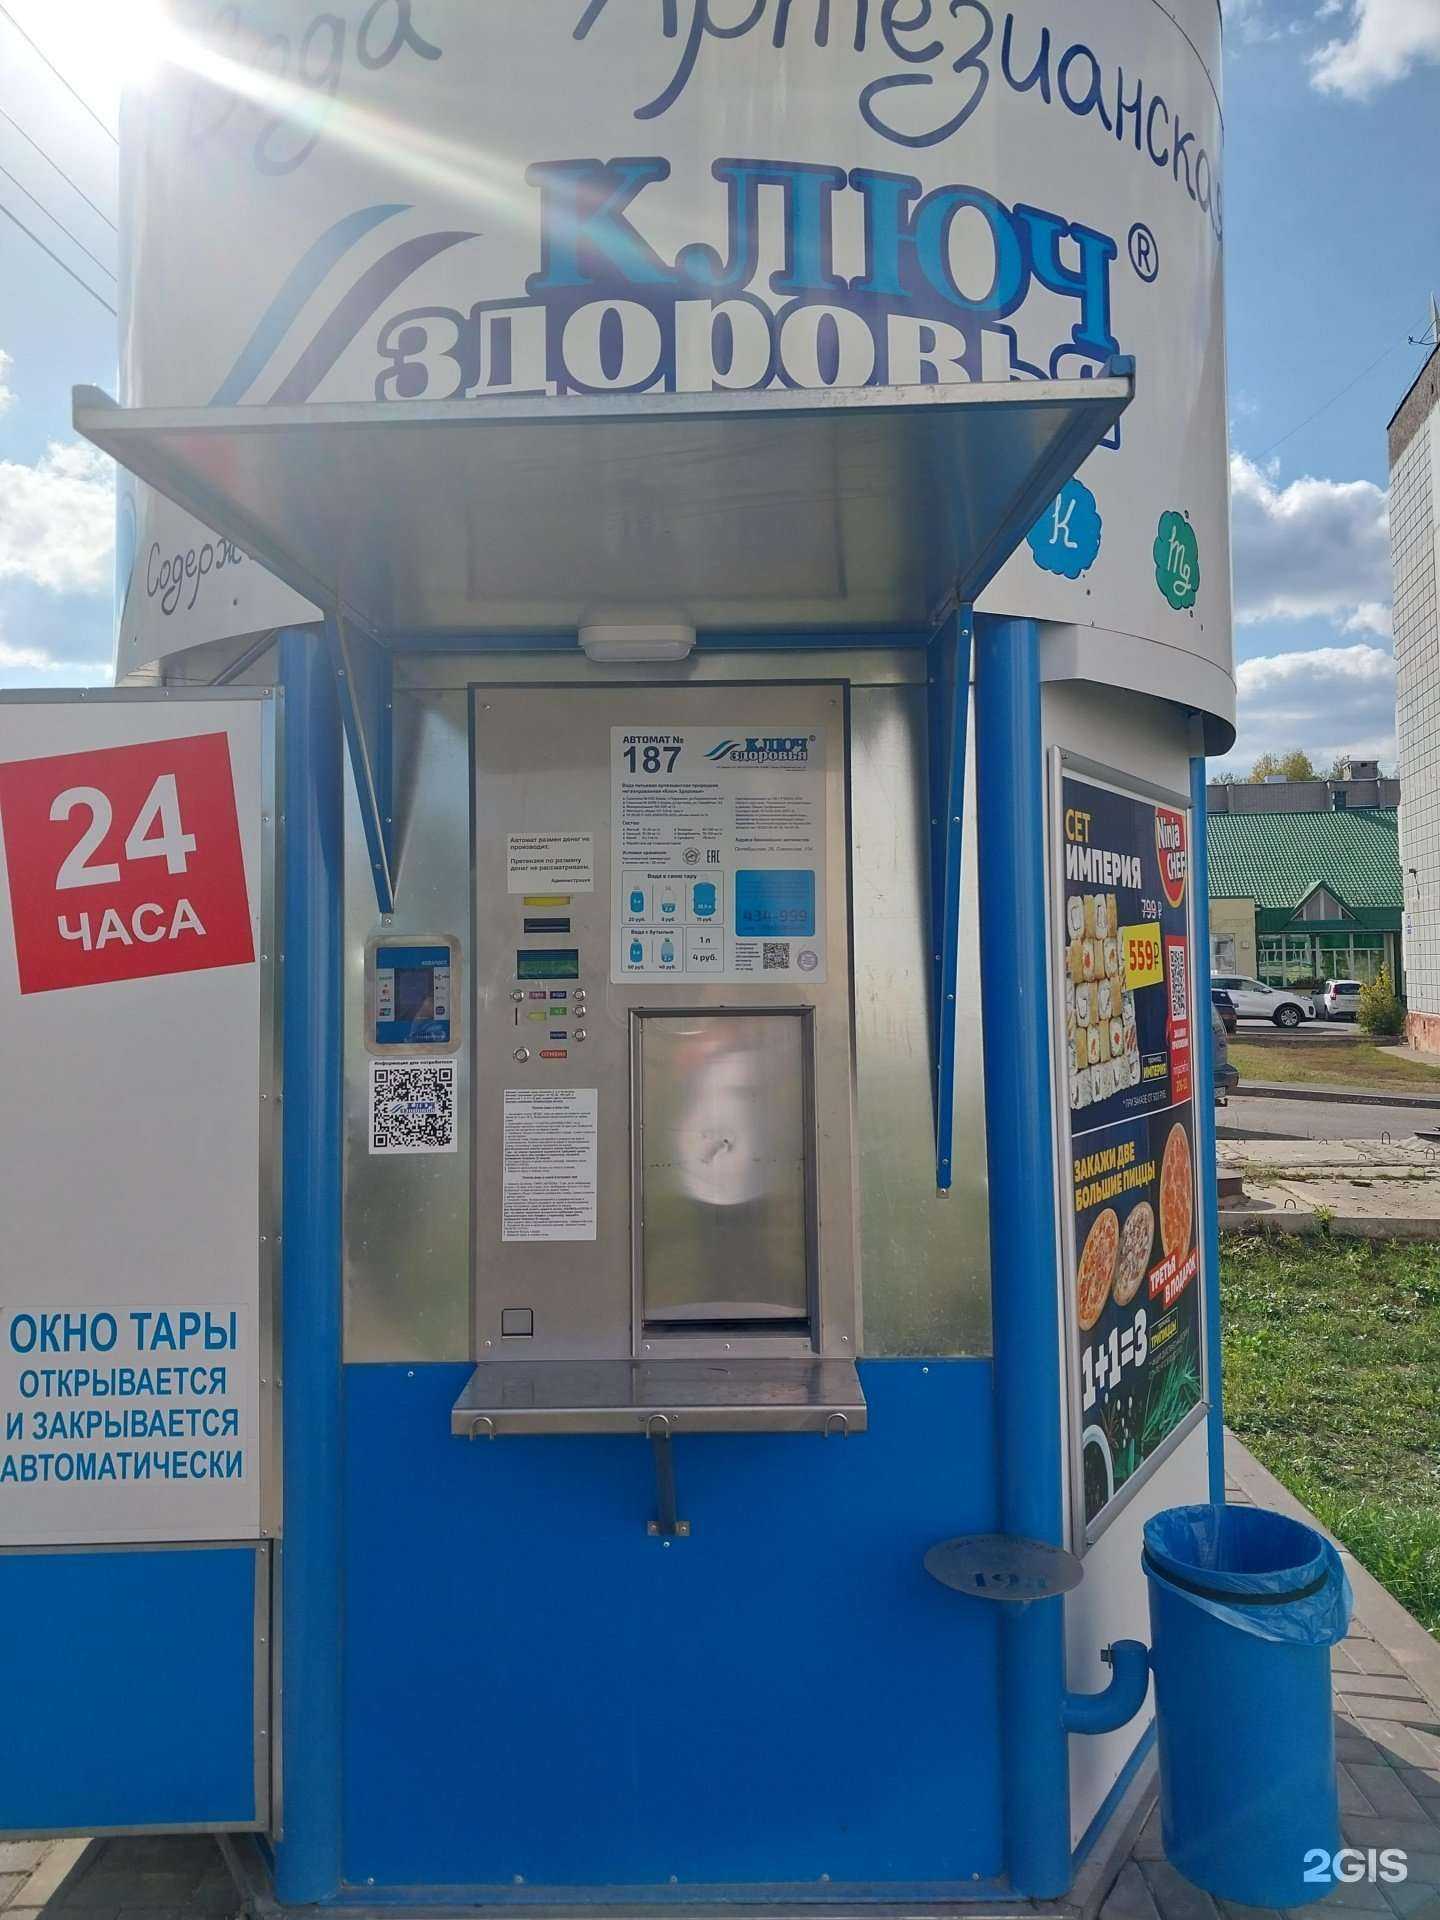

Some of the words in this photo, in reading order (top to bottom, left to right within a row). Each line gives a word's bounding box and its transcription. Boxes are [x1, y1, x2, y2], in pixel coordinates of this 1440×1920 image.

[526, 156, 1118, 352] КЛЮЧ
[622, 735, 671, 745] АВТОМАТ
[745, 737, 808, 752] КЛЮЧ
[622, 745, 682, 774] 187
[48, 773, 197, 891] 24
[1065, 808, 1091, 843] СЕТ
[1156, 815, 1180, 851] Ninja
[1066, 843, 1142, 889] ИМПЕРИЯ
[56, 897, 208, 952] ЧАСА
[699, 954, 718, 963] руб.
[1074, 1147, 1117, 1183] ЗАКАЖИ
[1117, 1141, 1136, 1169] ДВЕ
[1075, 1174, 1124, 1212] БОЛЬШИЕ
[1123, 1159, 1156, 1191] ПИЦЦЫ
[1150, 1255, 1176, 1293] ТРЕТЬЯ
[9, 1312, 118, 1354] ОКНО
[130, 1311, 237, 1351] ТАРЫ
[1082, 1308, 1148, 1412] 1+1=3
[19, 1366, 227, 1398] ОТКРЫВАЕТСЯ
[6, 1411, 24, 1440] И
[32, 1408, 239, 1440] ЗАКРЫВАЕТСЯ
[0, 1450, 243, 1482] АВТОМАТИЧЕСКИ
